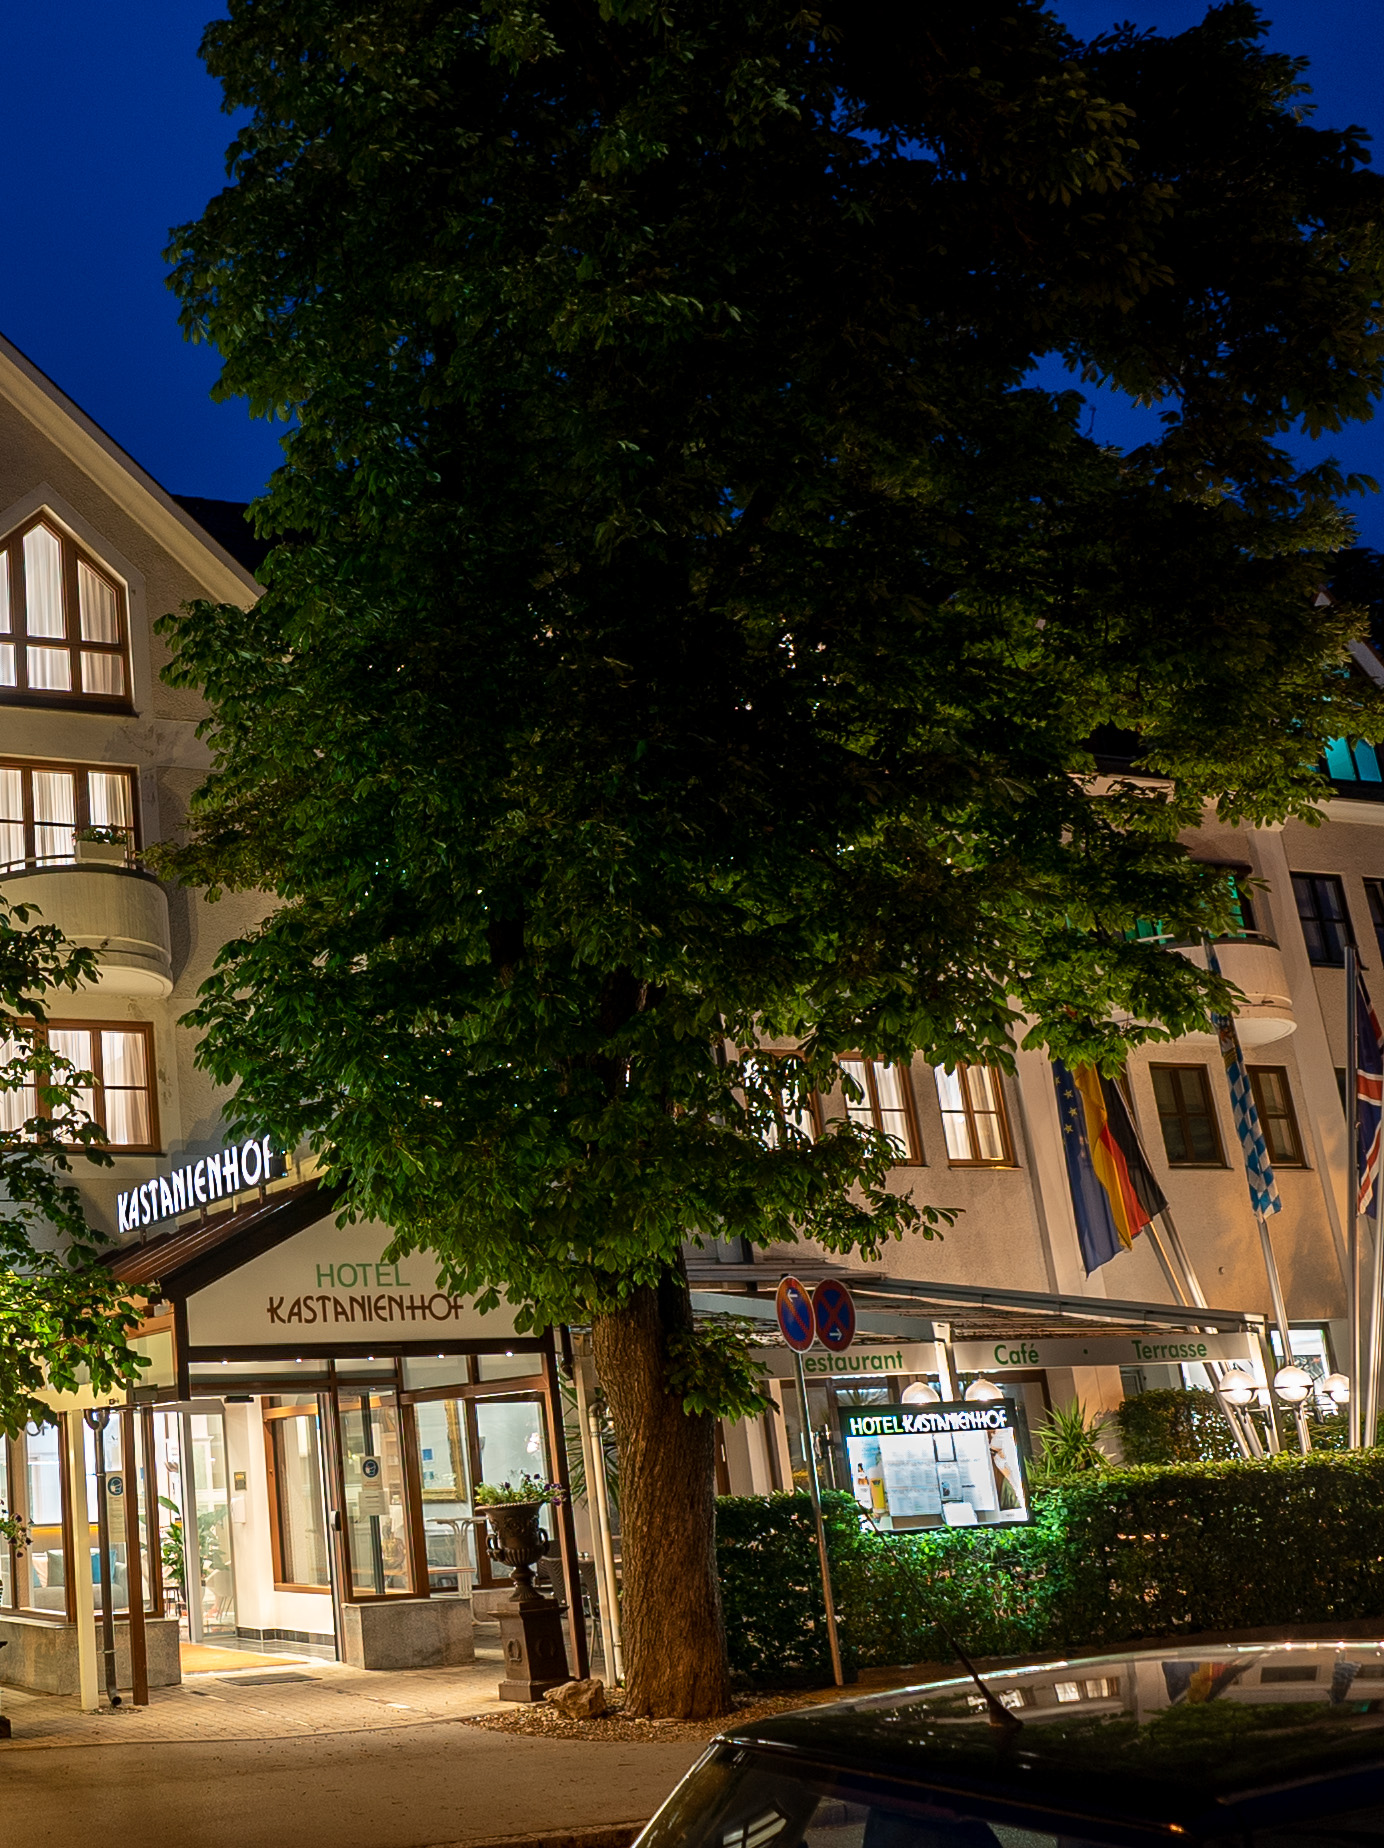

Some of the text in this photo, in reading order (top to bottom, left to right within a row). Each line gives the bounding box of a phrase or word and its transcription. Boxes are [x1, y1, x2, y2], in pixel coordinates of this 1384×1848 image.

[117, 1133, 274, 1234] KASTANIENHOF
[316, 1262, 411, 1289] HOTEL
[267, 1293, 465, 1325] KASTANIENHOF
[804, 1339, 1208, 1373] estaurant Café Terrasse
[849, 1415, 904, 1436] HOTEL
